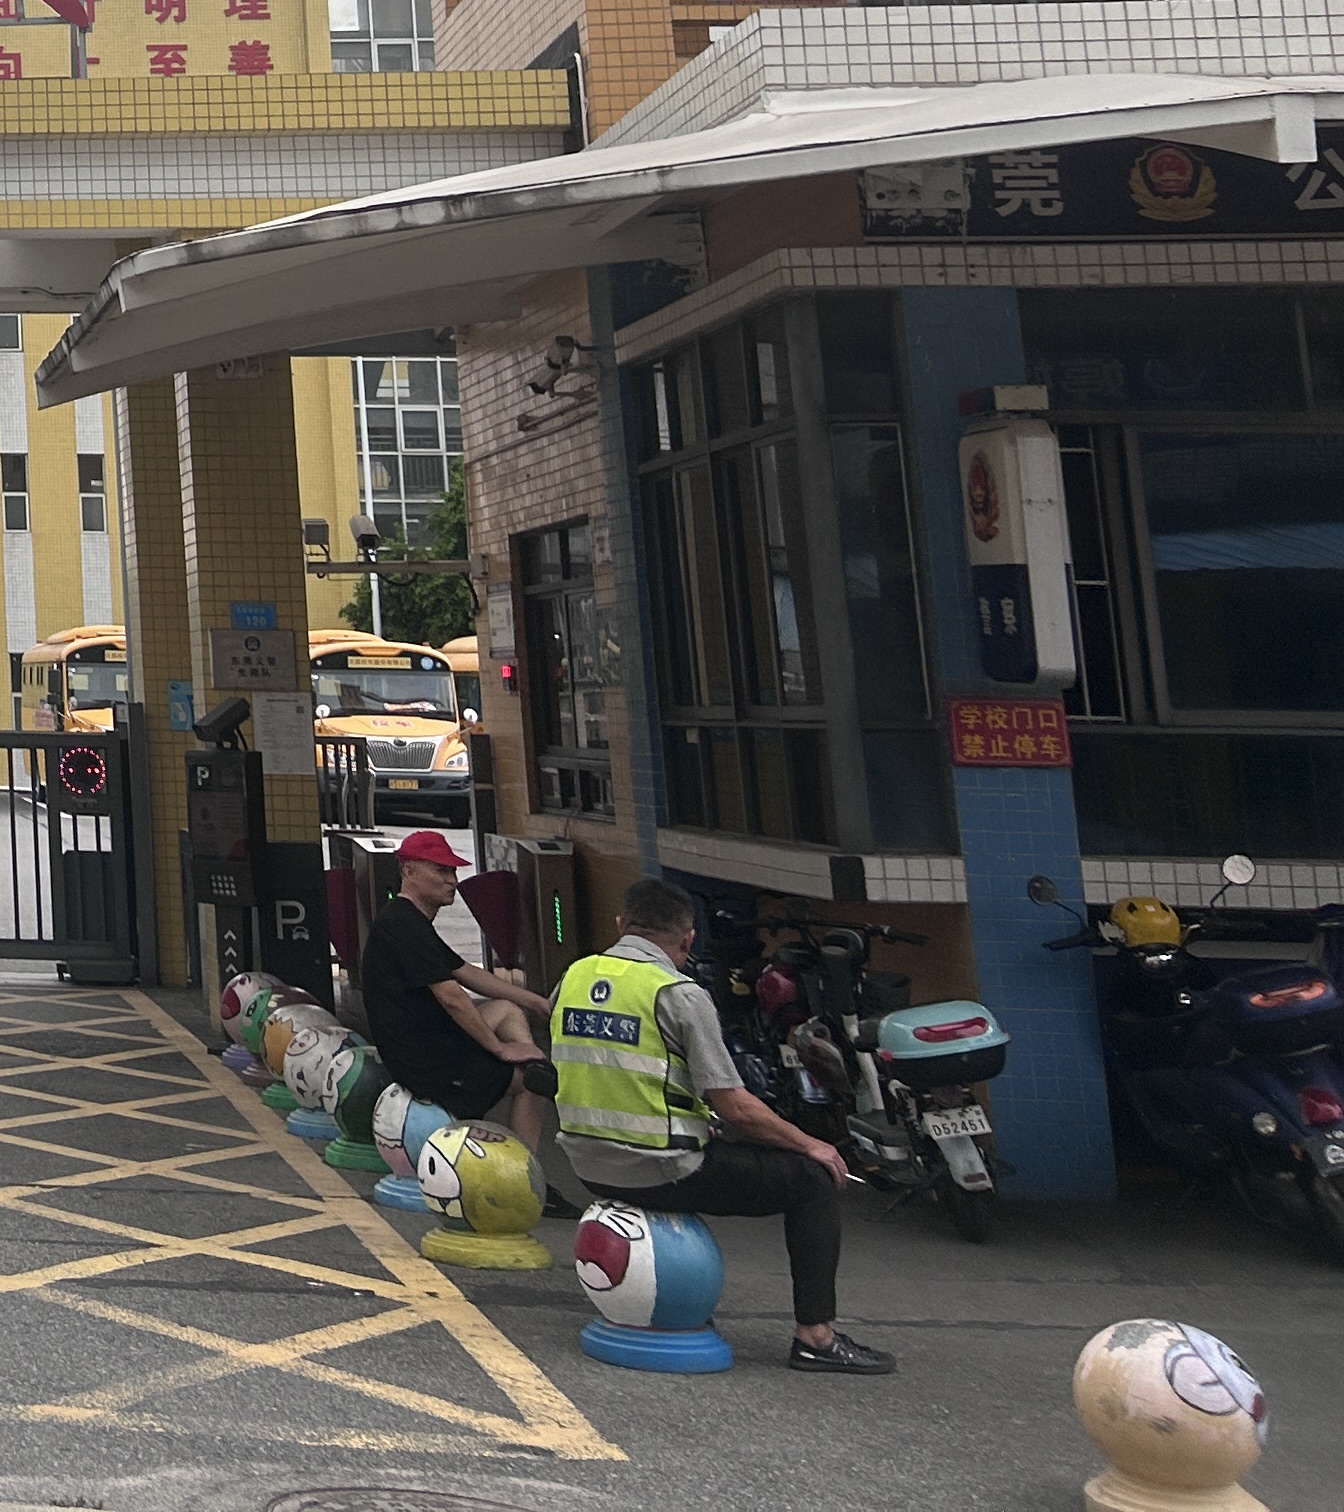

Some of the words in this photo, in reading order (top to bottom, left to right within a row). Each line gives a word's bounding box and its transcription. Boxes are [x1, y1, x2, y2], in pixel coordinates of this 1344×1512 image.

[988, 150, 1064, 217] 莞
[960, 705, 1059, 730] 学校门口
[963, 734, 1062, 759] 禁止停车
[197, 766, 210, 786] P
[275, 900, 306, 940] P
[932, 1119, 987, 1138] D52451
